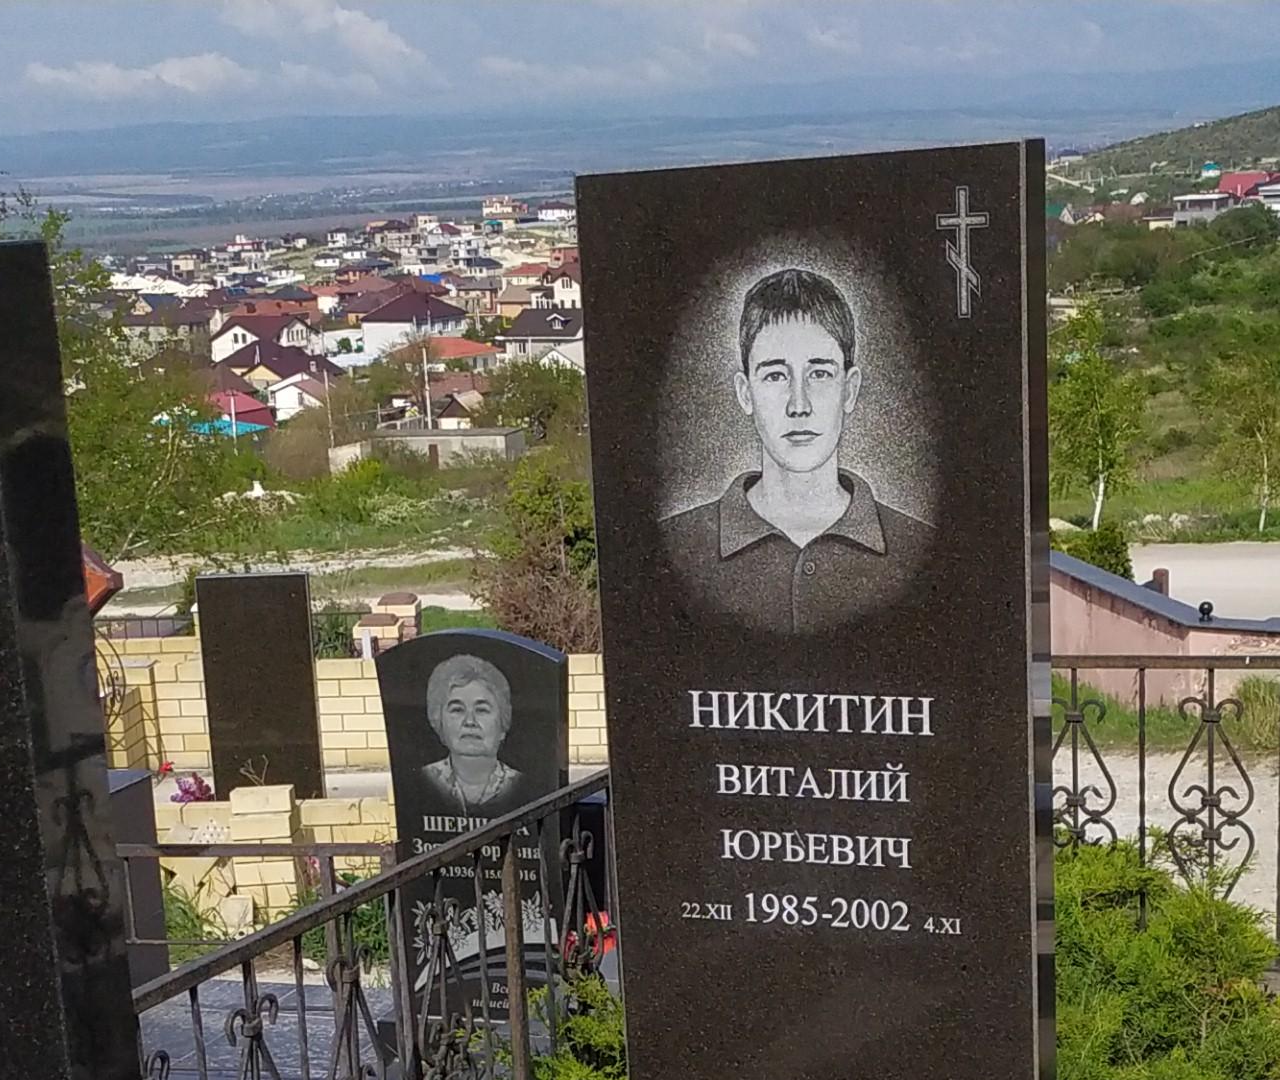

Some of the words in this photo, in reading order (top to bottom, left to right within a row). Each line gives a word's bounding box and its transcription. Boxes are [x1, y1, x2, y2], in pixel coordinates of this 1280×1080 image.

[687, 690, 935, 736] НИКИТИН
[716, 762, 911, 802] ВИТАЛИЙ
[720, 829, 913, 868] ЮРЬЕВИЧ
[681, 902, 732, 920] 22.XII
[745, 892, 910, 931] 1985-2002
[923, 916, 962, 934] 4.XI
